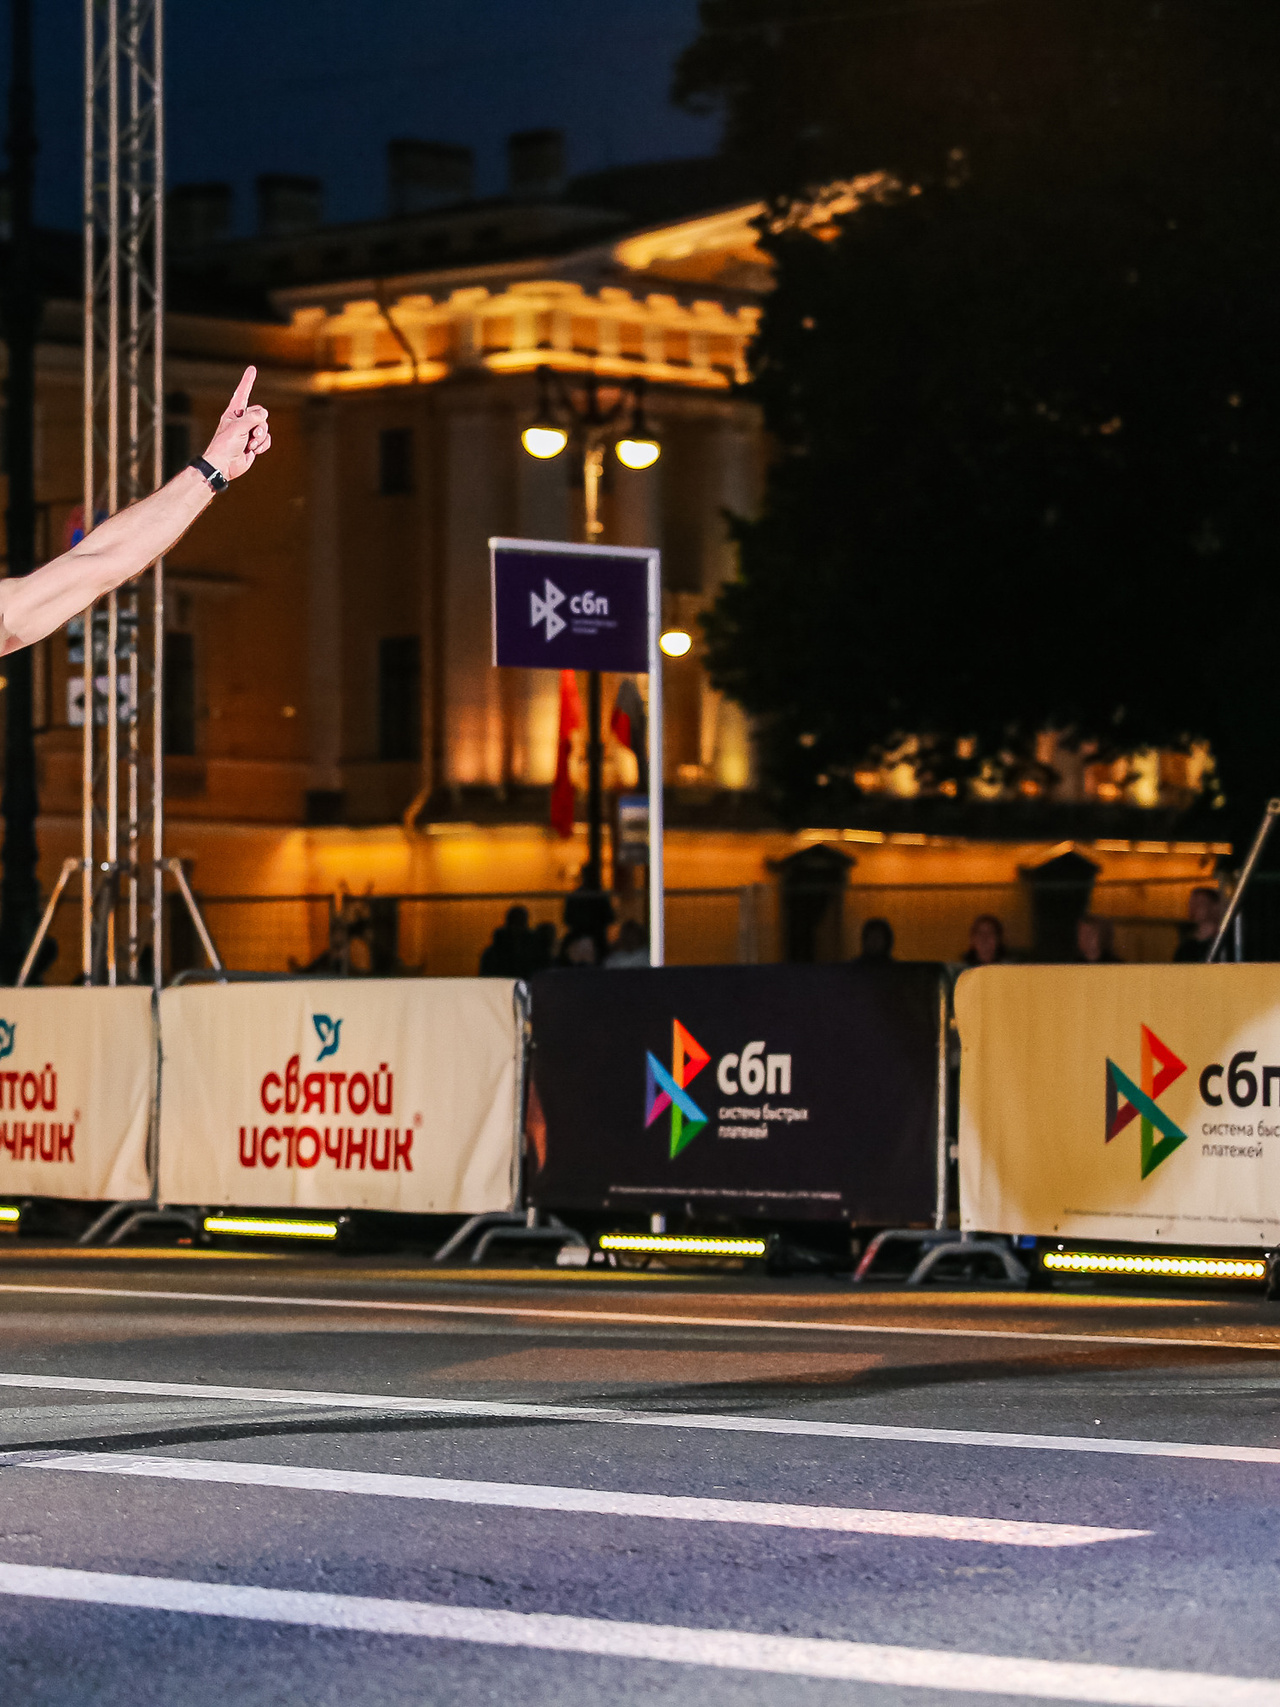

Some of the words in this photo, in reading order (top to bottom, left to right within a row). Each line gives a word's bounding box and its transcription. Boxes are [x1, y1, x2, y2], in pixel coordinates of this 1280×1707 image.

[261, 1053, 393, 1115] святой
[717, 1041, 792, 1096] сбп
[238, 1125, 414, 1172] источник
[1201, 1122, 1253, 1137] система
[1201, 1141, 1263, 1159] платежей
